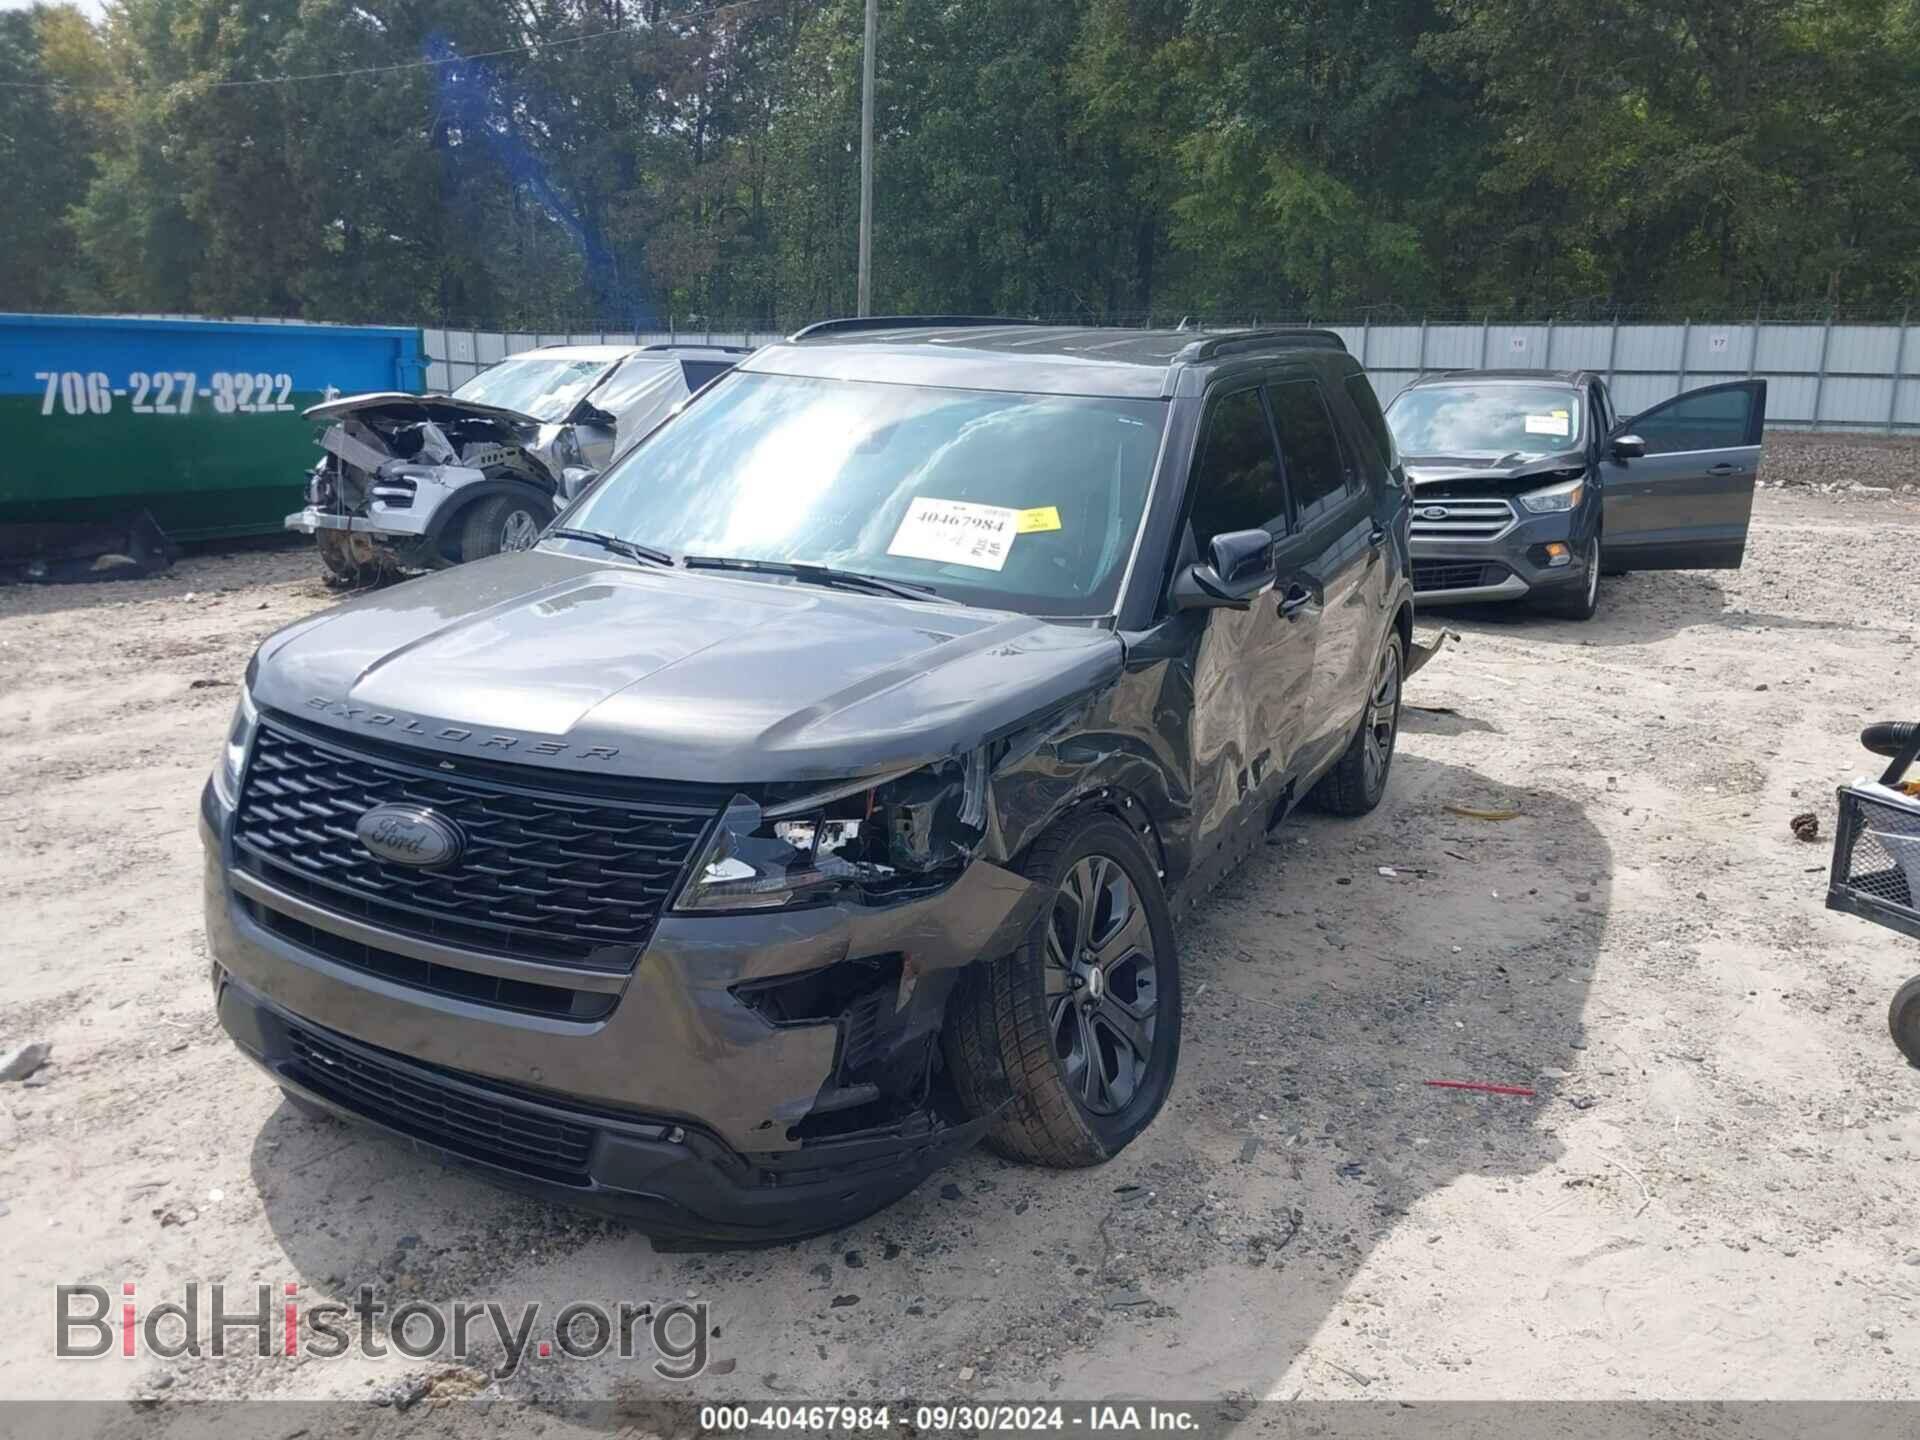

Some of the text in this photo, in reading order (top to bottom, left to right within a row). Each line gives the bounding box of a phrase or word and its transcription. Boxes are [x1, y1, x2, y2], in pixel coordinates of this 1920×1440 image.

[35, 372, 294, 415] 706-227-3222
[917, 511, 1005, 532] 40467984
[306, 696, 620, 761] EXPLORER
[371, 819, 427, 855] Ford
